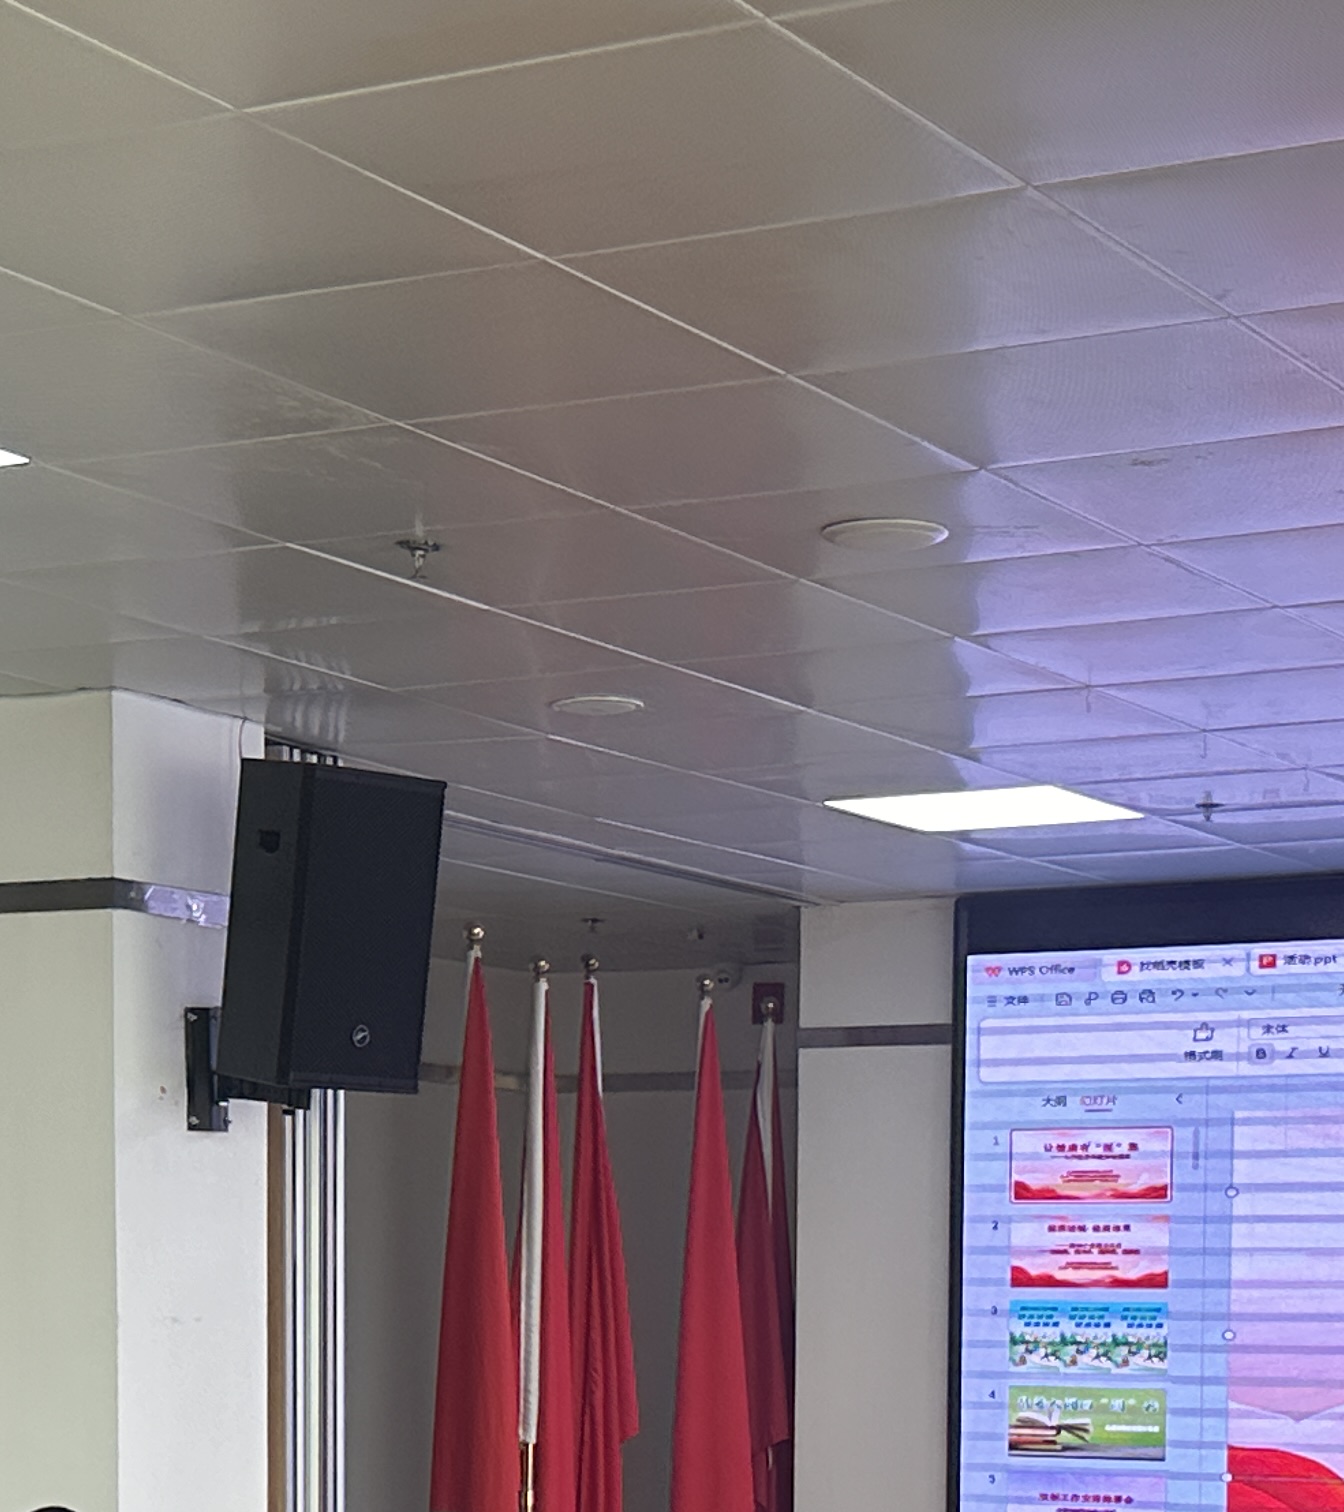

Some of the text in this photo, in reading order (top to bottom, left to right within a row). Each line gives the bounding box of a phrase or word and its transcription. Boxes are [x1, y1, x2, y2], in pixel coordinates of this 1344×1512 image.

[1007, 963, 1076, 977] WPS Office
[1004, 994, 1030, 1007] 文件
